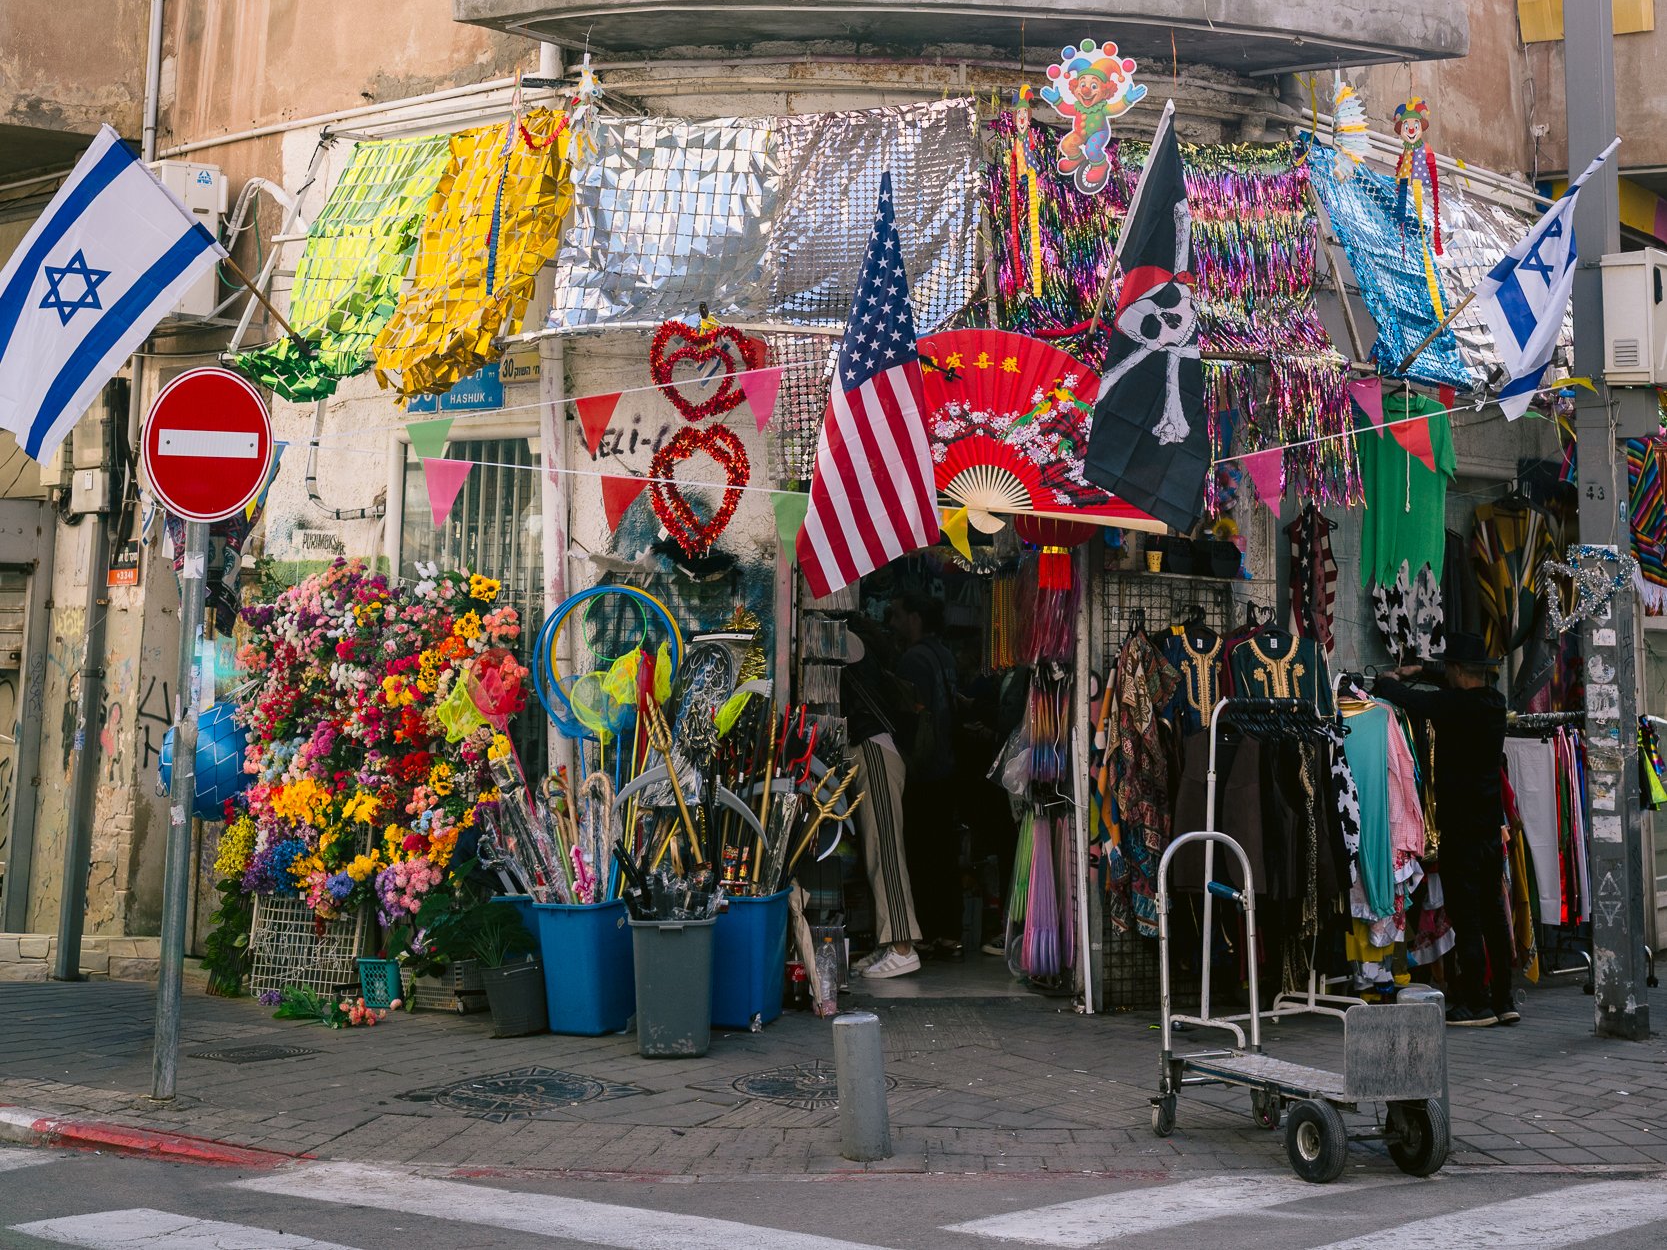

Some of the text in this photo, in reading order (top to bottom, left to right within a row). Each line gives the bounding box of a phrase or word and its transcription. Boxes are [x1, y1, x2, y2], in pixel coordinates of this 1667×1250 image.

[502, 358, 514, 378] 30
[450, 392, 486, 405] HASHUK
[1586, 486, 1605, 500] 43
